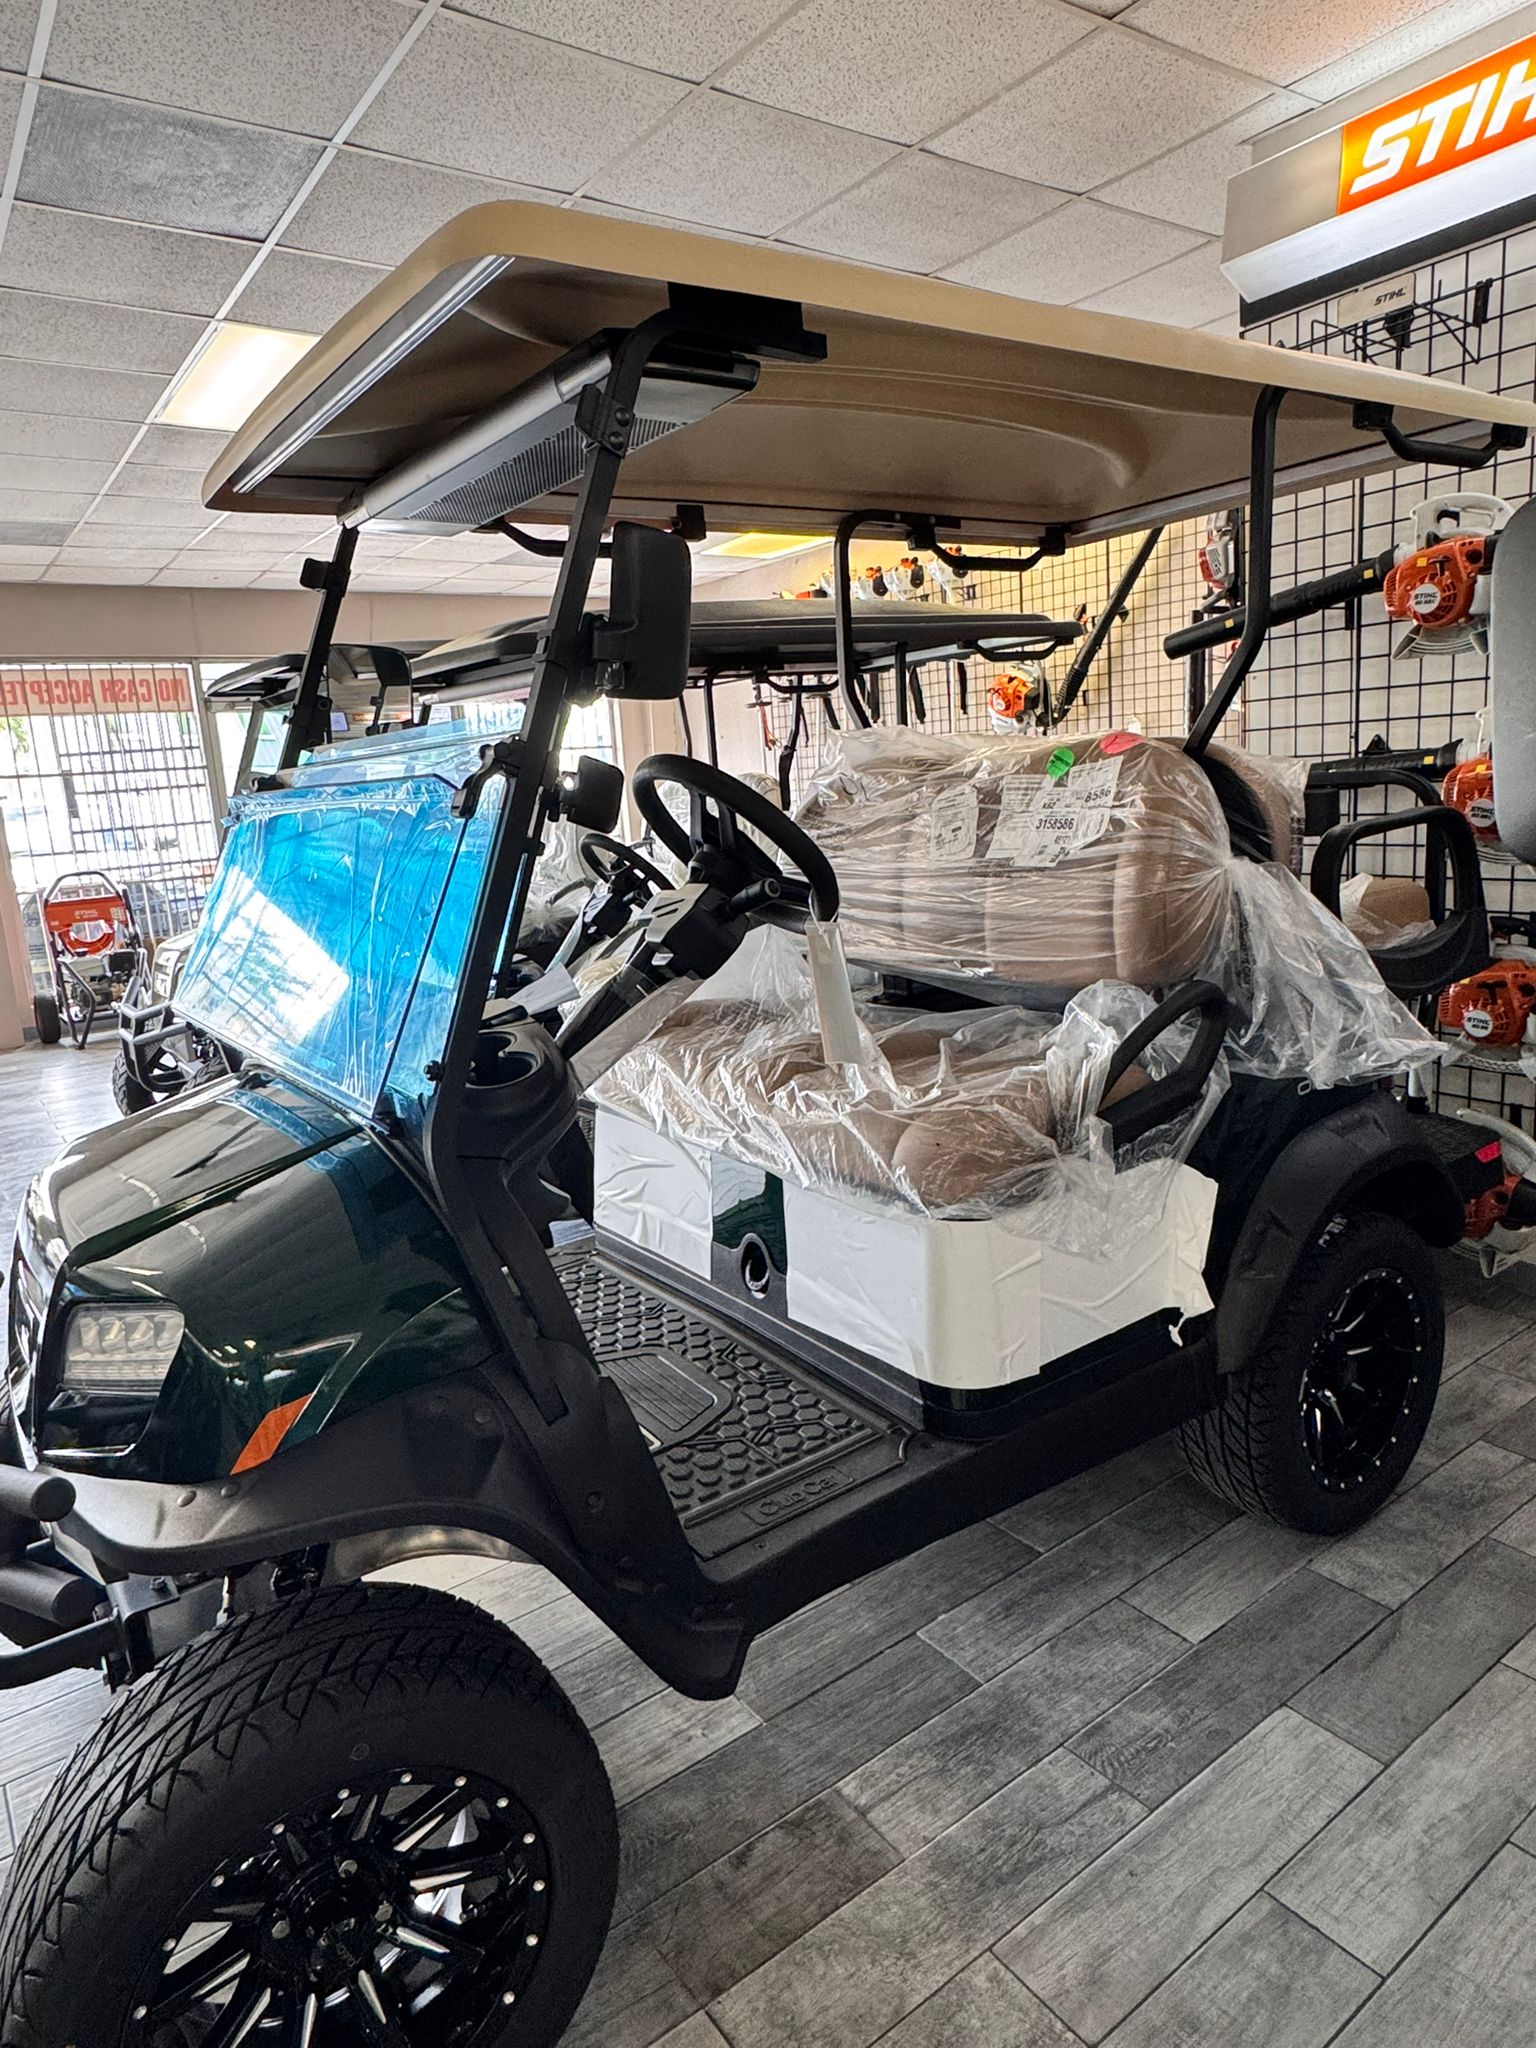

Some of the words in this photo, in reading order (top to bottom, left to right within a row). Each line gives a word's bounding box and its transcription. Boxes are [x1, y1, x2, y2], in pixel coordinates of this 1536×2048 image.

[1374, 287, 1406, 306] STIHL
[1084, 785, 1111, 803] 8586
[1035, 817, 1075, 830] 3158586
